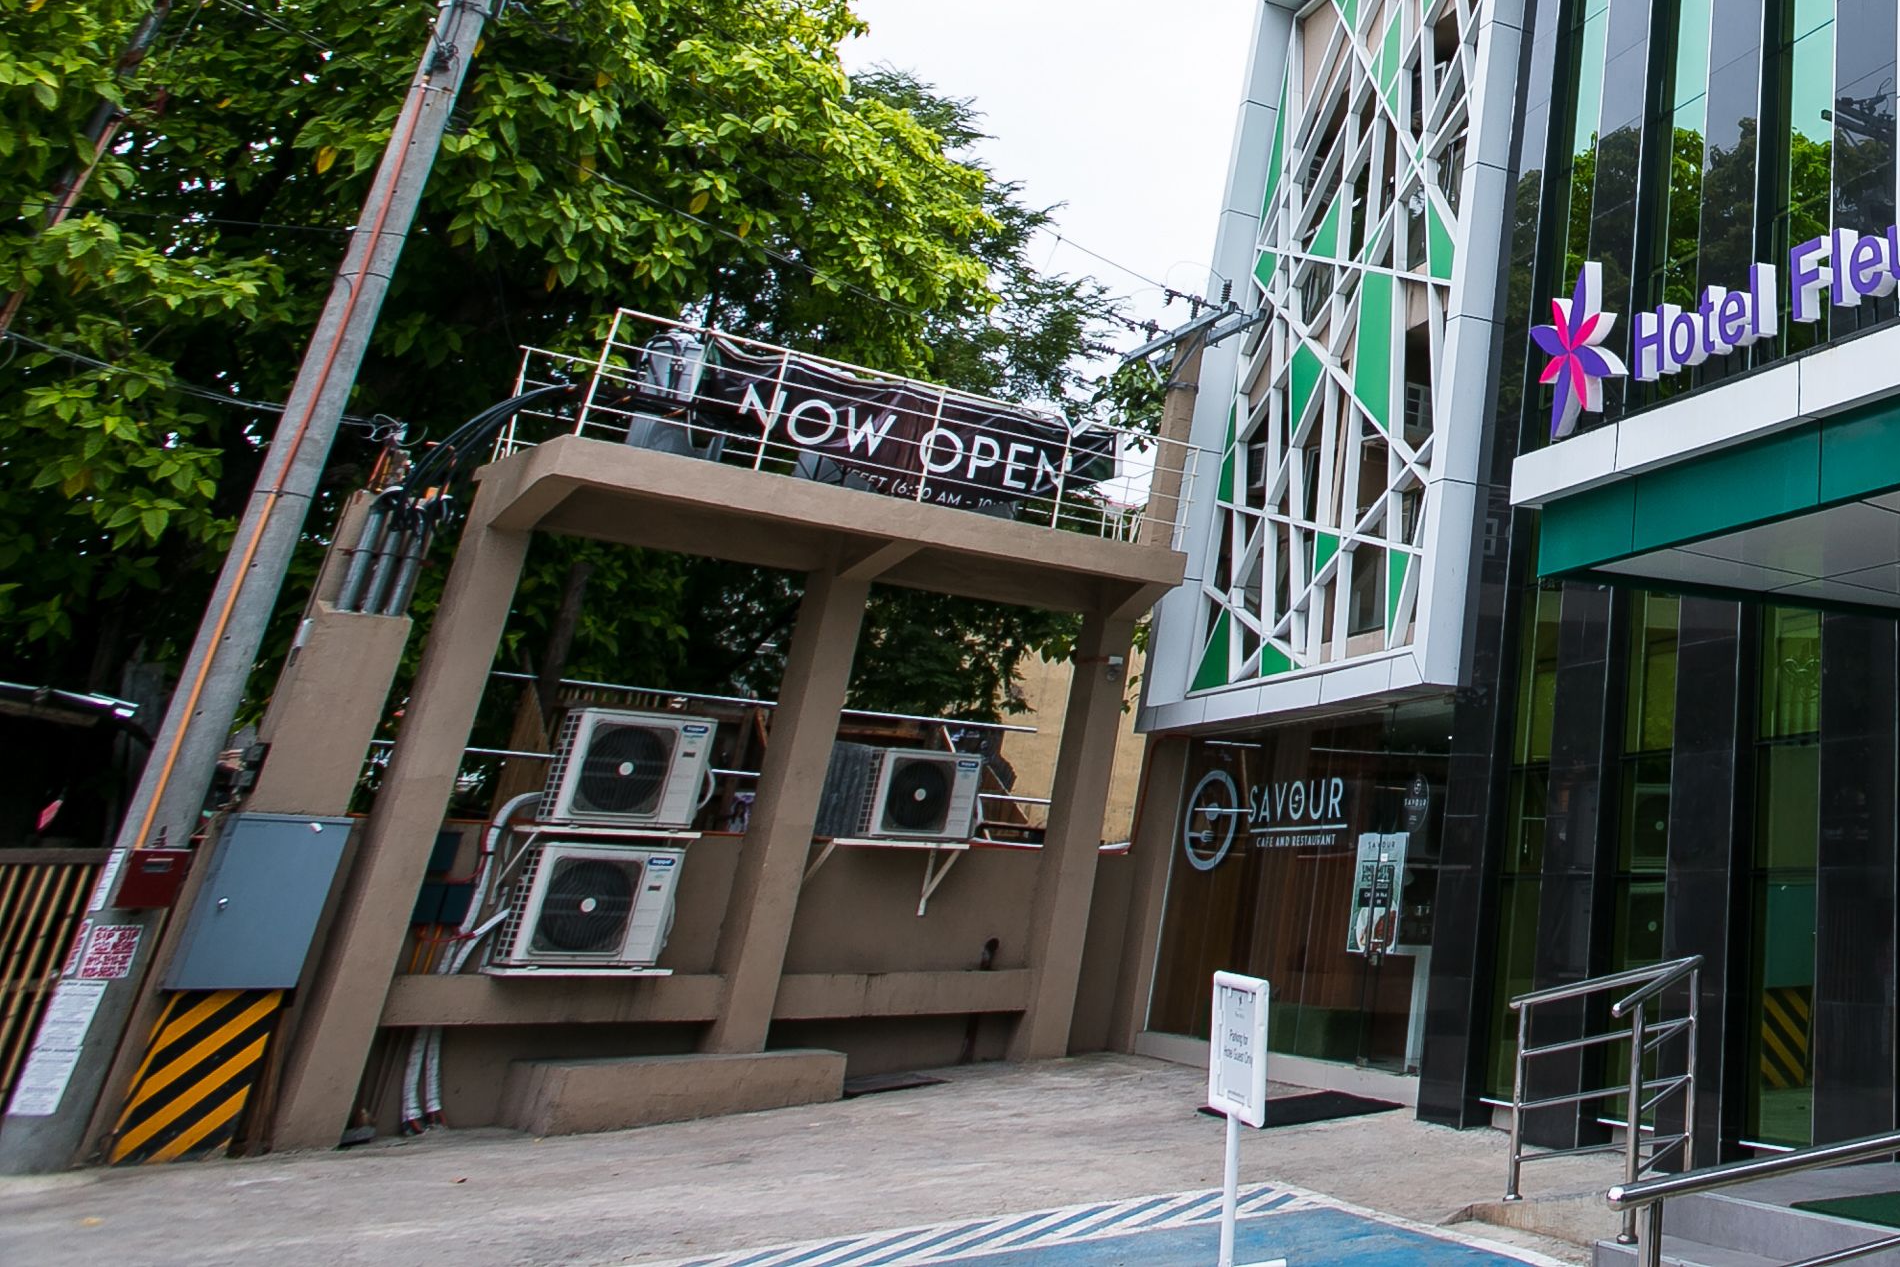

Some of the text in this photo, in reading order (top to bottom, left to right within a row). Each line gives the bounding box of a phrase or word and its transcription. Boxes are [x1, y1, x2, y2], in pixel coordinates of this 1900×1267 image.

[1634, 263, 1777, 382] Hotel
[739, 383, 1066, 492] NOW OPEN
[936, 491, 962, 506] AM
[1247, 777, 1344, 823] SAVOUR
[1256, 834, 1336, 848] CAFE AND RESTAURANT
